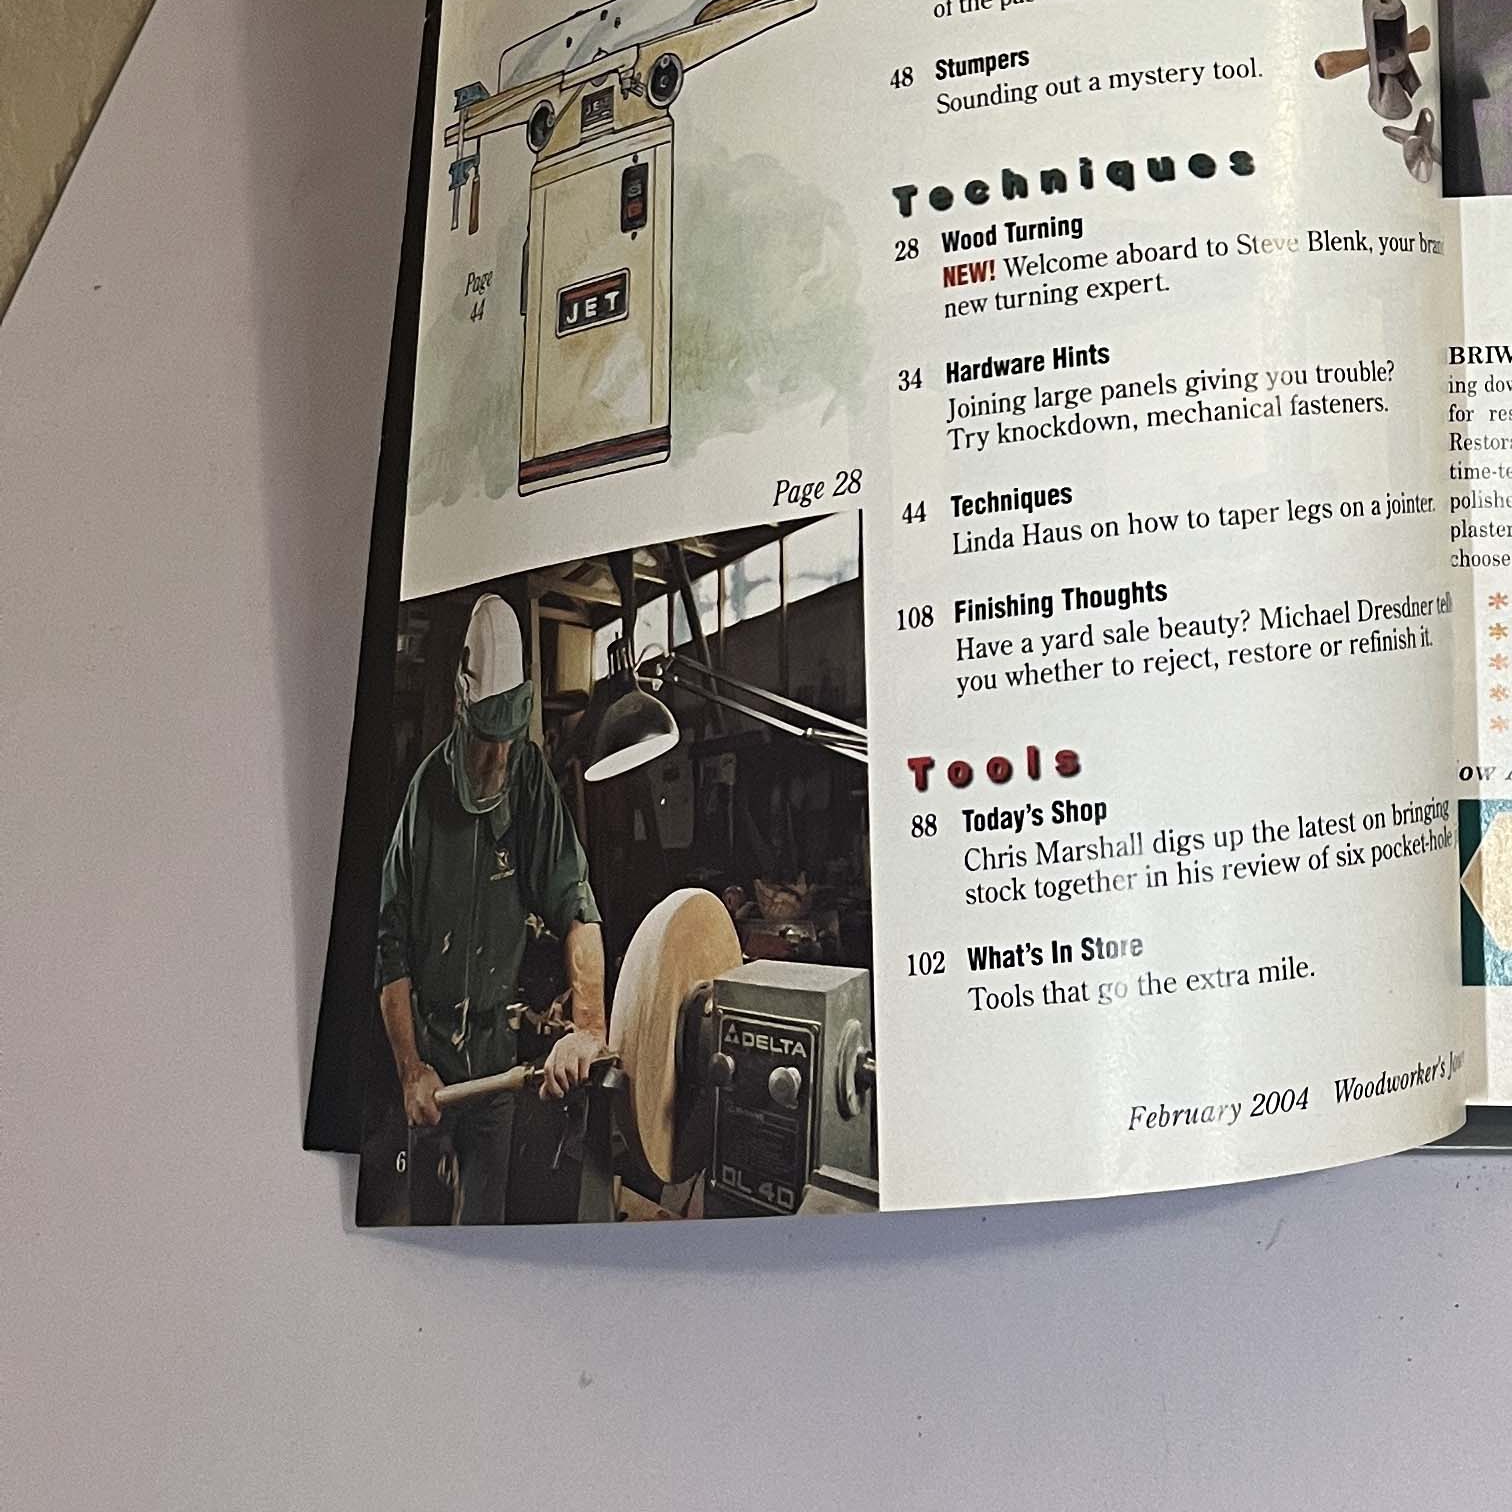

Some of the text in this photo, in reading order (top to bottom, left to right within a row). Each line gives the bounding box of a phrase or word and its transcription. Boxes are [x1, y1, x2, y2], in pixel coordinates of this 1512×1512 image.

[889, 49, 1030, 90] 48 Stumpers
[936, 56, 1263, 115] Sounding out a mystery tool.
[893, 150, 1256, 218] Techniques
[894, 215, 1084, 263] 28 Wood Turning
[463, 270, 494, 298] Page
[469, 297, 487, 324] 44
[567, 291, 619, 324] JET
[898, 343, 1111, 392] 34 Hardware Hints
[945, 393, 1389, 453] Try knockdown, mechanical fasteners.
[1447, 402, 1475, 423] for
[772, 468, 863, 509] Page 28
[901, 486, 1073, 525] 44 Techniques
[896, 580, 1168, 632] 108 Finishing Thoughts
[907, 746, 1082, 793] Tools
[910, 799, 1108, 839] 88 Today's Shop
[907, 936, 1144, 977] 102 What's In Store
[742, 1032, 807, 1058] DELTA
[1127, 1055, 1446, 1132] February 2004 Woodworker's
[395, 1150, 406, 1173] 6
